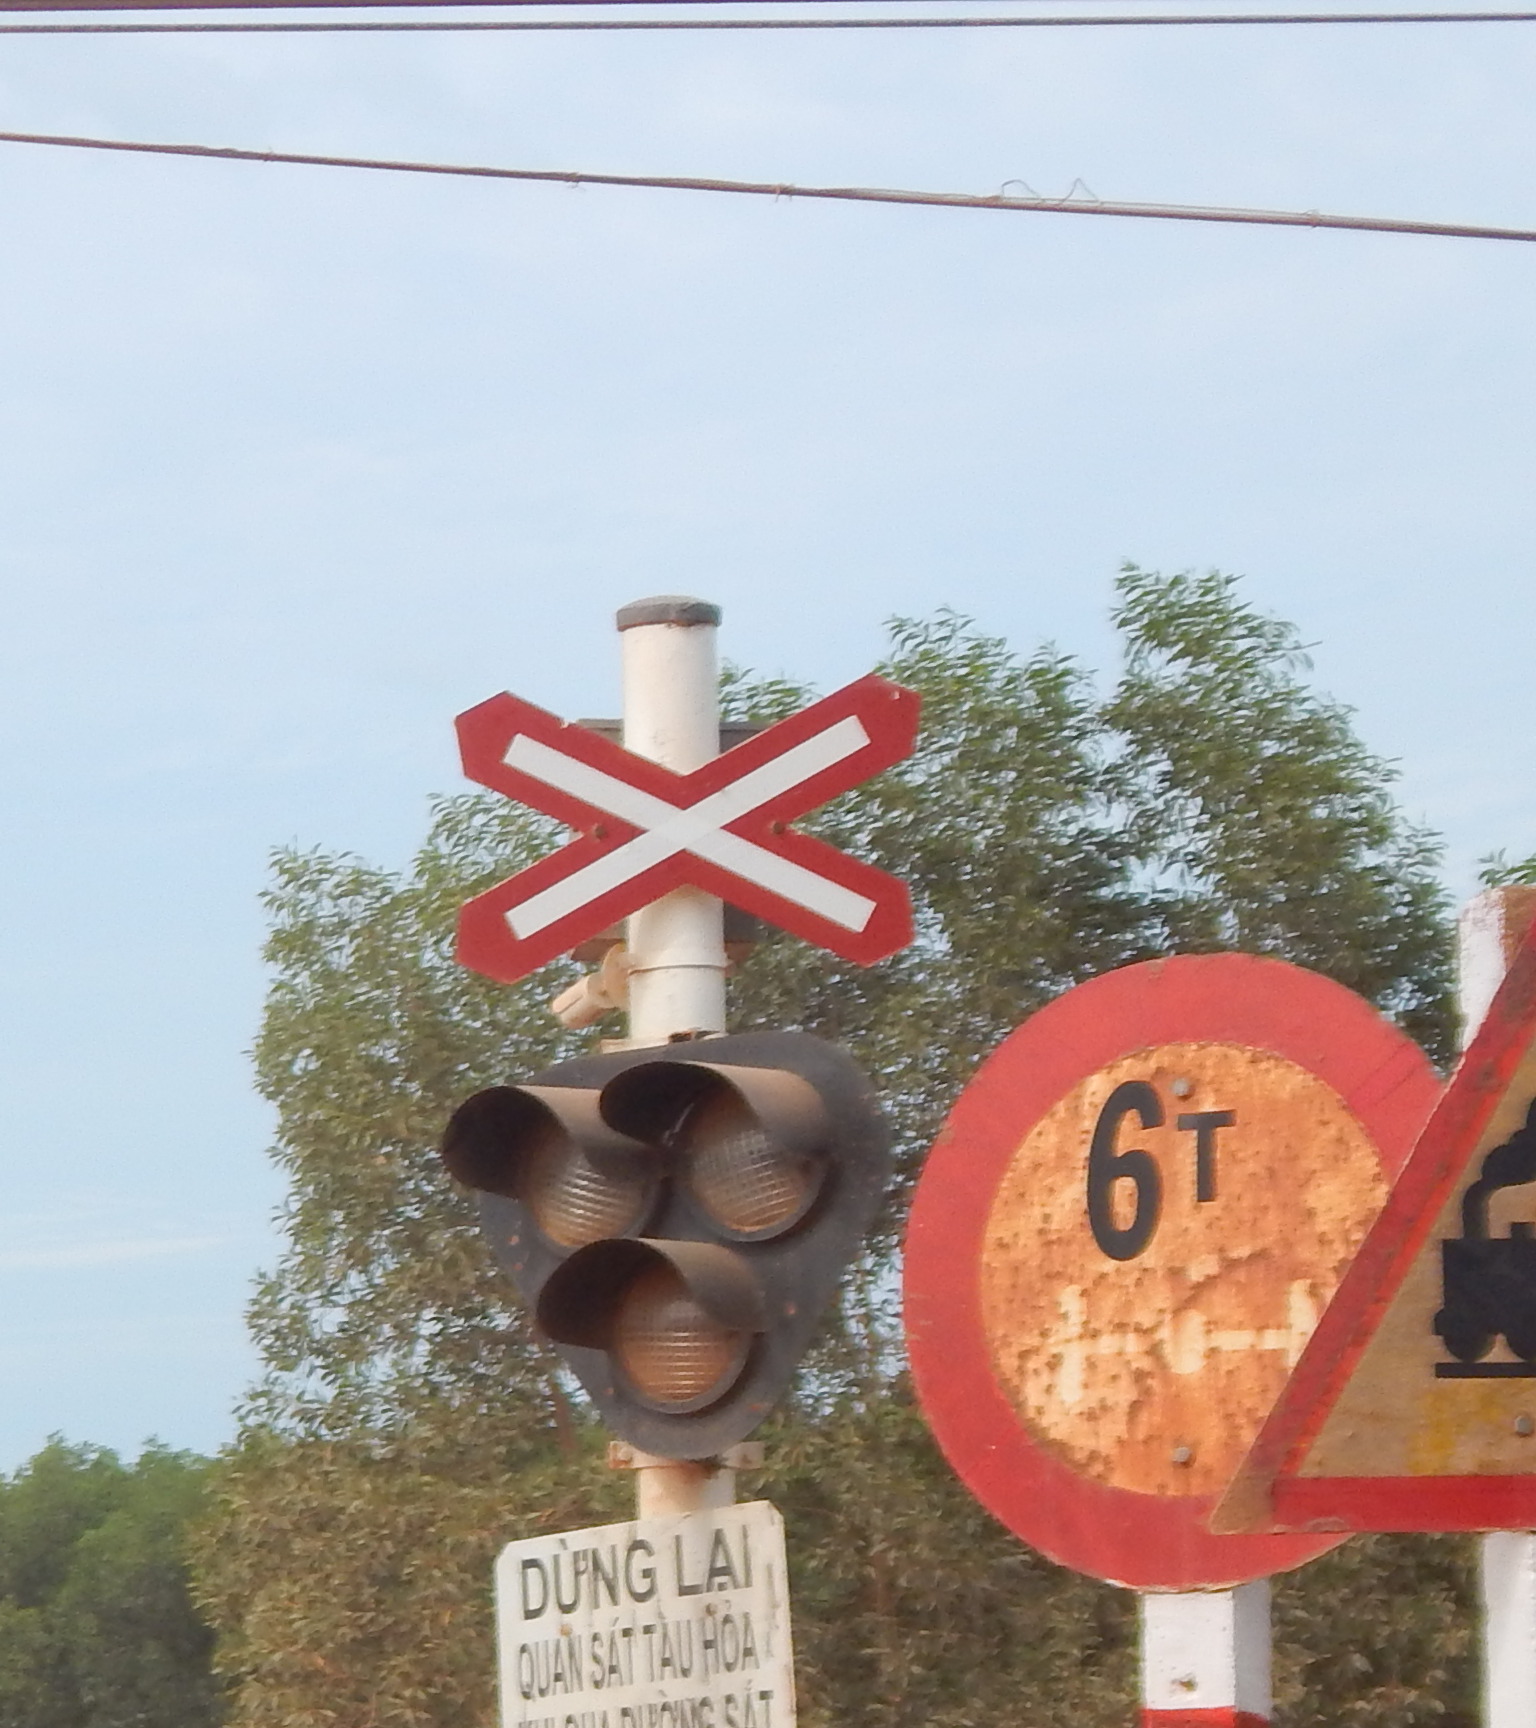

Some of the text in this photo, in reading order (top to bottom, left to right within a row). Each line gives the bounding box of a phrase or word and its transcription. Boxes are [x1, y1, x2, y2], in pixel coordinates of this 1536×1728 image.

[520, 1523, 754, 1621] DỪNG LẠI
[590, 1616, 635, 1690] SÁT
[642, 1612, 694, 1683] TÀU
